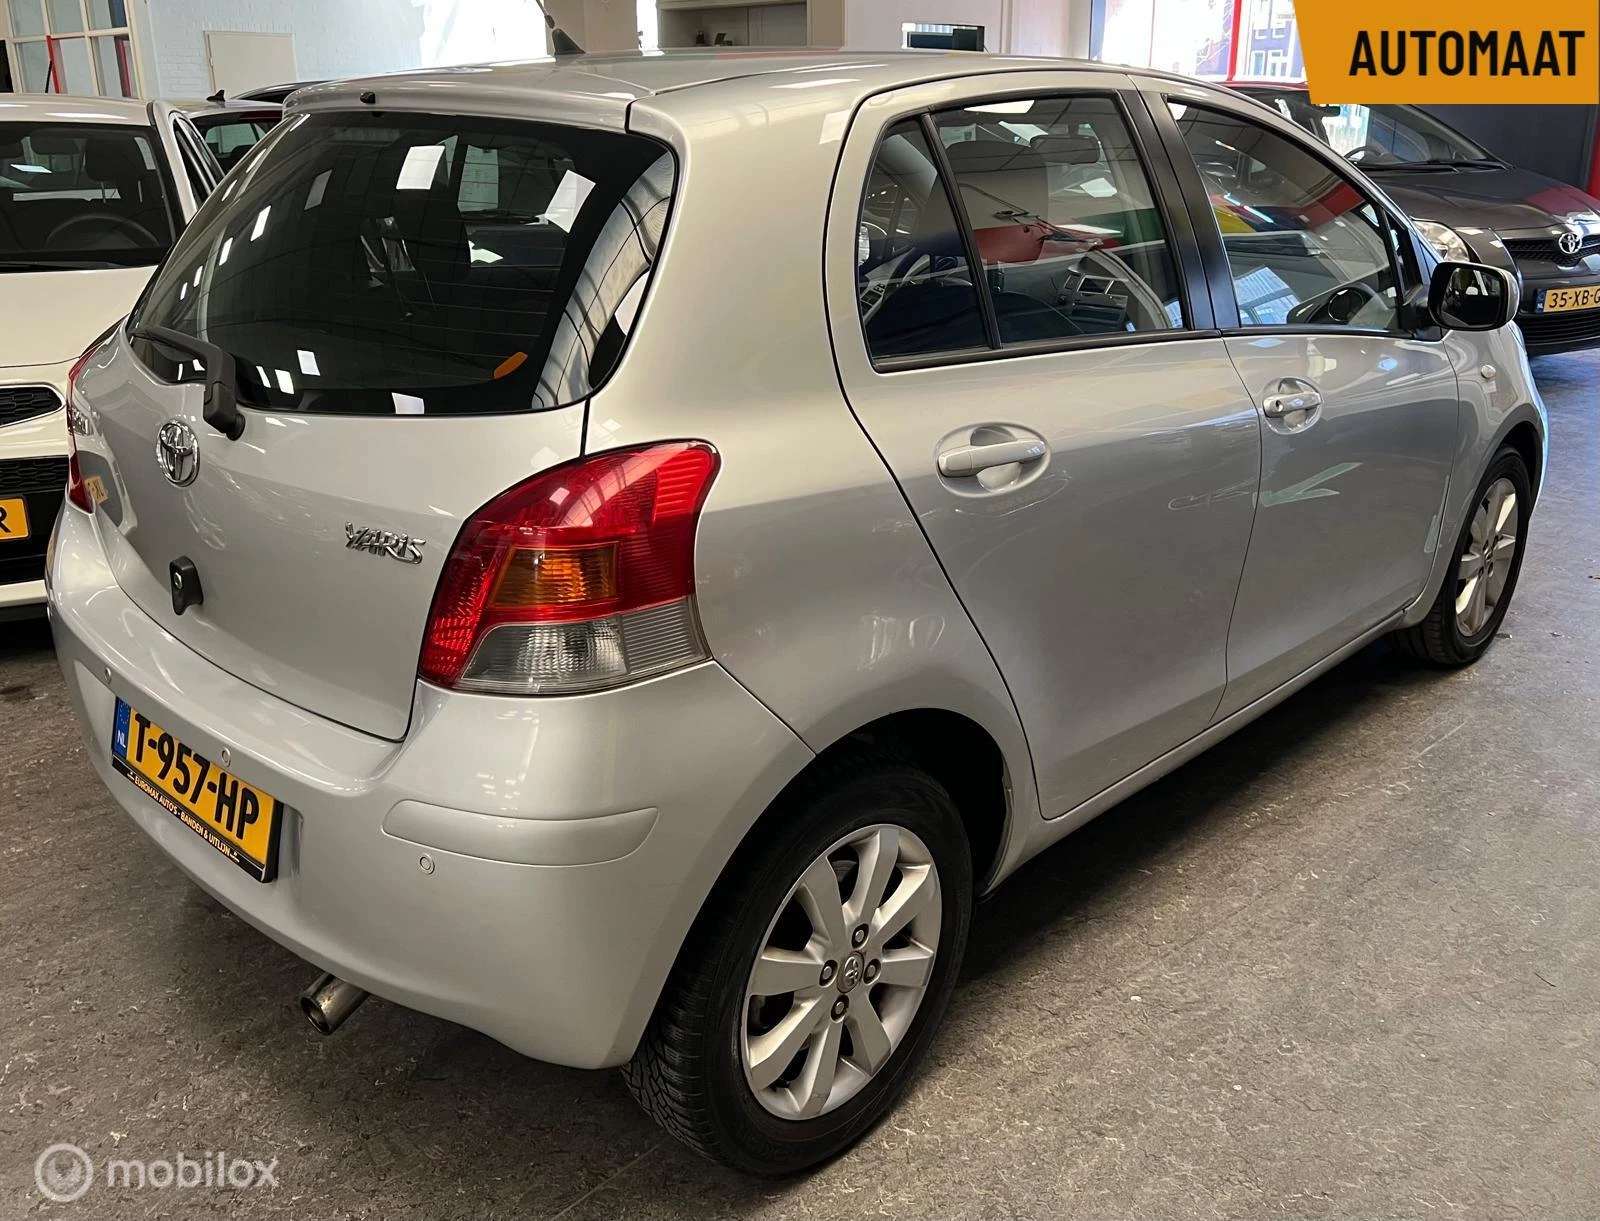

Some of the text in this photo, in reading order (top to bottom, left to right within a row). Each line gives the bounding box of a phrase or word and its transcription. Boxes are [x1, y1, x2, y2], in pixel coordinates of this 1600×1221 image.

[117, 730, 127, 748] NL
[134, 776, 159, 801] EUROMAX
[180, 811, 204, 836] BANDEN
[135, 713, 260, 840] T-957-HP
